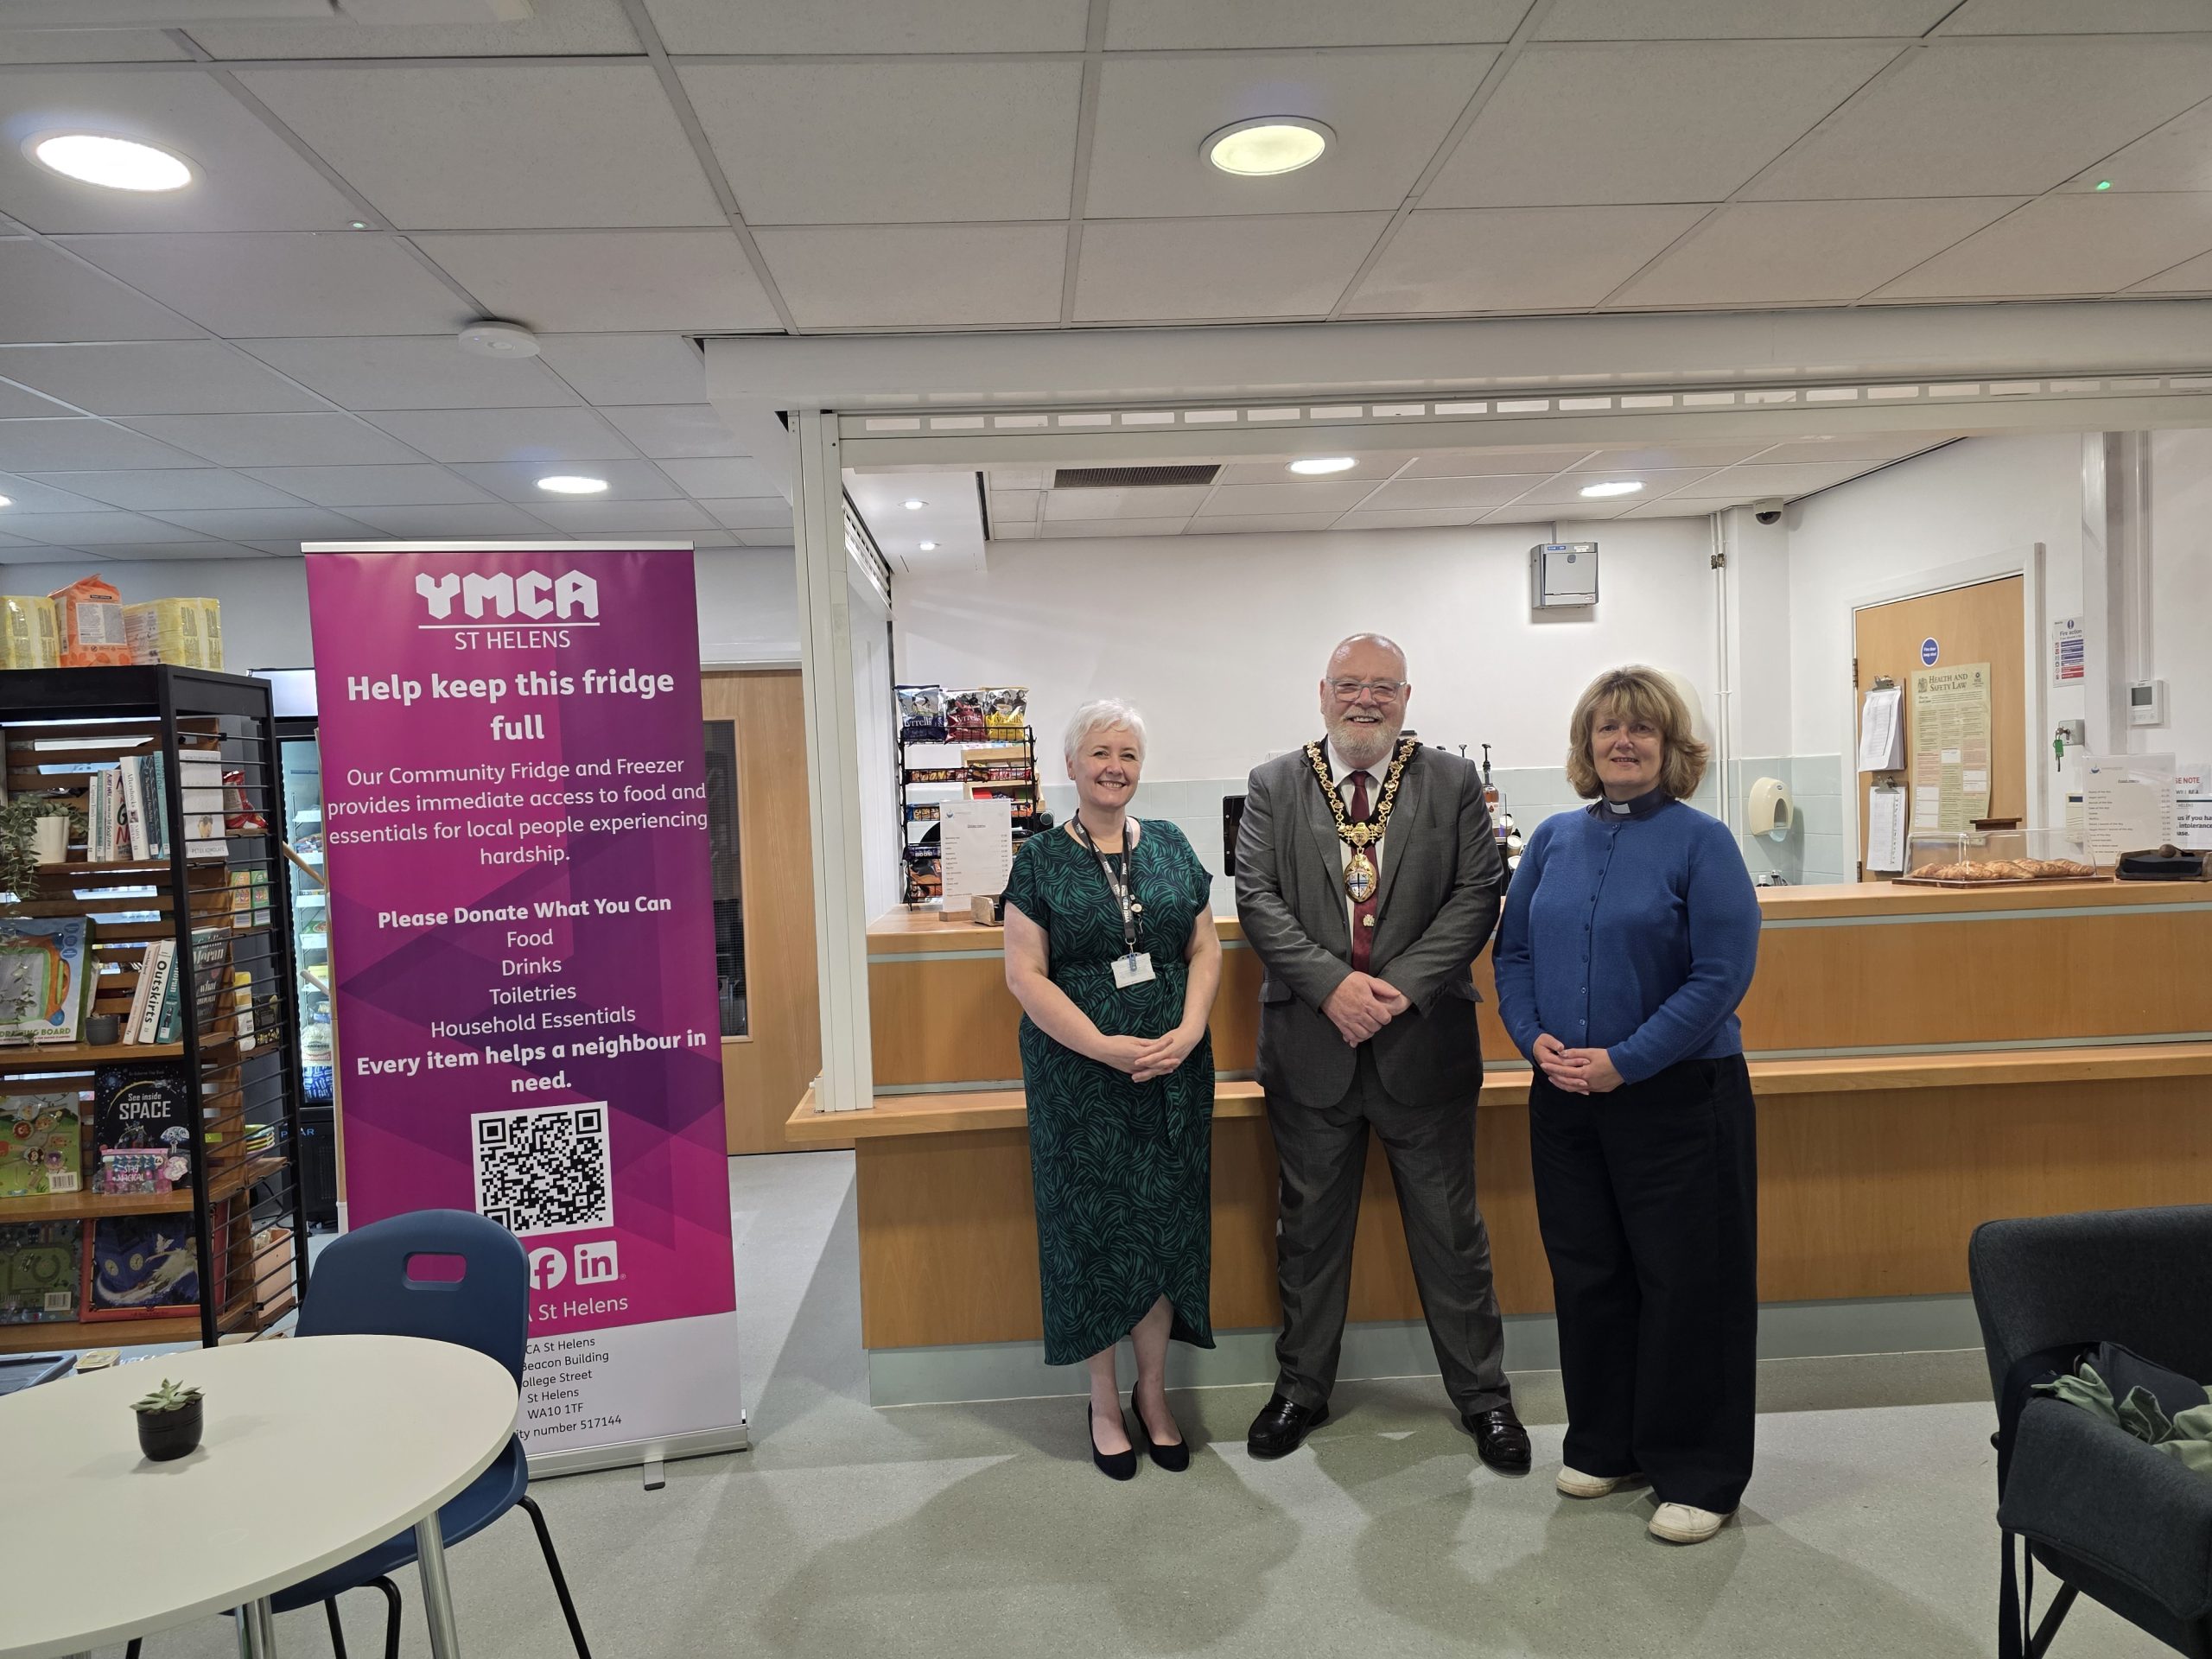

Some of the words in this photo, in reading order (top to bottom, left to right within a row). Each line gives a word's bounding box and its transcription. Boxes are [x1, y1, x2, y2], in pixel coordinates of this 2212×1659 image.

[416, 569, 599, 620] YMCA
[454, 632, 480, 651] ST
[487, 631, 571, 650] HELENS
[347, 673, 422, 706] Help
[432, 672, 506, 703] keep
[516, 671, 575, 696] this
[582, 668, 674, 699] fridge
[1929, 675, 1953, 683] HEALTH
[1929, 683, 1951, 692] SAFETY
[1952, 681, 1967, 690] LAW
[491, 715, 544, 741] full
[347, 769, 383, 786] Our
[390, 764, 505, 785] Community
[512, 761, 569, 782] Fridge
[575, 760, 611, 777] and
[617, 758, 684, 775] Freezer
[327, 795, 410, 819] provides
[416, 791, 524, 813] immediate
[530, 790, 594, 807] access
[599, 787, 618, 804] to
[624, 785, 665, 802] food
[672, 783, 706, 800] and
[329, 823, 428, 845] essentials
[434, 822, 461, 840] for
[467, 819, 513, 838] local
[518, 816, 584, 840] people
[589, 811, 708, 835] experiencing
[480, 848, 570, 865] hardship.
[378, 909, 448, 929] Please
[454, 905, 528, 925] Donate
[534, 900, 589, 919] What
[594, 898, 631, 916] You
[635, 896, 671, 912] Can
[507, 930, 553, 948] Food
[502, 957, 562, 977] Drinks
[144, 960, 168, 1023] Outskirts
[490, 984, 576, 1005] Toiletries
[431, 1014, 536, 1039] Household
[542, 1006, 636, 1030] Essentials
[357, 1056, 420, 1078] Every
[427, 1048, 479, 1070] item
[486, 1043, 545, 1069] helps
[552, 1046, 565, 1058] a
[572, 1033, 680, 1059] neighbour
[688, 1030, 706, 1047] in
[511, 1071, 572, 1093] need.
[128, 1093, 140, 1102] See
[142, 1092, 162, 1101] inside
[119, 1101, 171, 1120] SPACE
[580, 1249, 612, 1278] in
[539, 1304, 557, 1320] St
[564, 1298, 628, 1317] Helens
[525, 1344, 540, 1354] CA
[544, 1343, 555, 1351] St
[558, 1338, 595, 1350] Helens
[565, 1351, 609, 1366] Building
[523, 1376, 556, 1387] ollege
[560, 1370, 593, 1382] Street
[528, 1394, 538, 1403] St
[542, 1389, 579, 1401] Helens
[528, 1406, 561, 1419] WA10
[565, 1403, 583, 1414] 1TF
[534, 1423, 576, 1436] number
[581, 1414, 621, 1429] 517144
